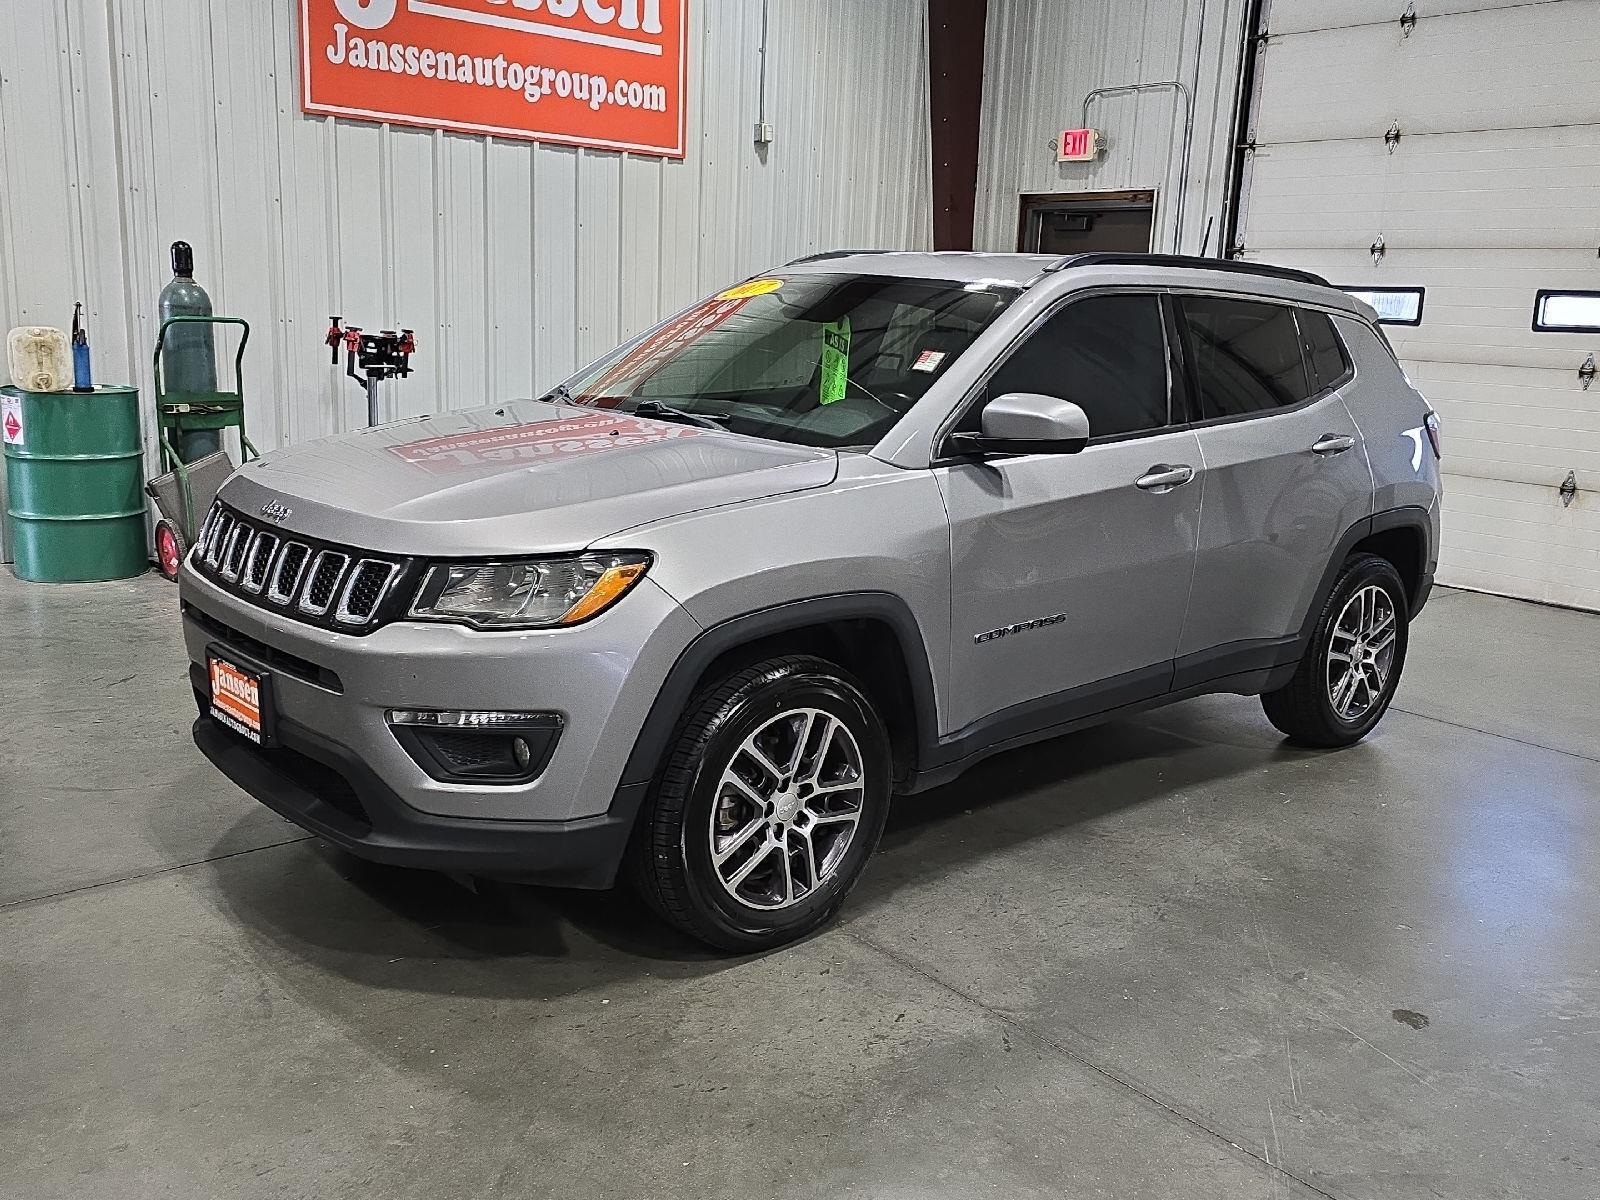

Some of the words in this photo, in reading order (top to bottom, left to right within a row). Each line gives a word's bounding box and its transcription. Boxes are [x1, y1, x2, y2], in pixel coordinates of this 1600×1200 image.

[326, 22, 666, 112] Janssenautogroup.com
[1063, 130, 1089, 156] EXIT
[830, 333, 839, 348] AS
[839, 338, 846, 352] IS
[974, 612, 1067, 644] COMPASS
[211, 658, 260, 707] Janssen
